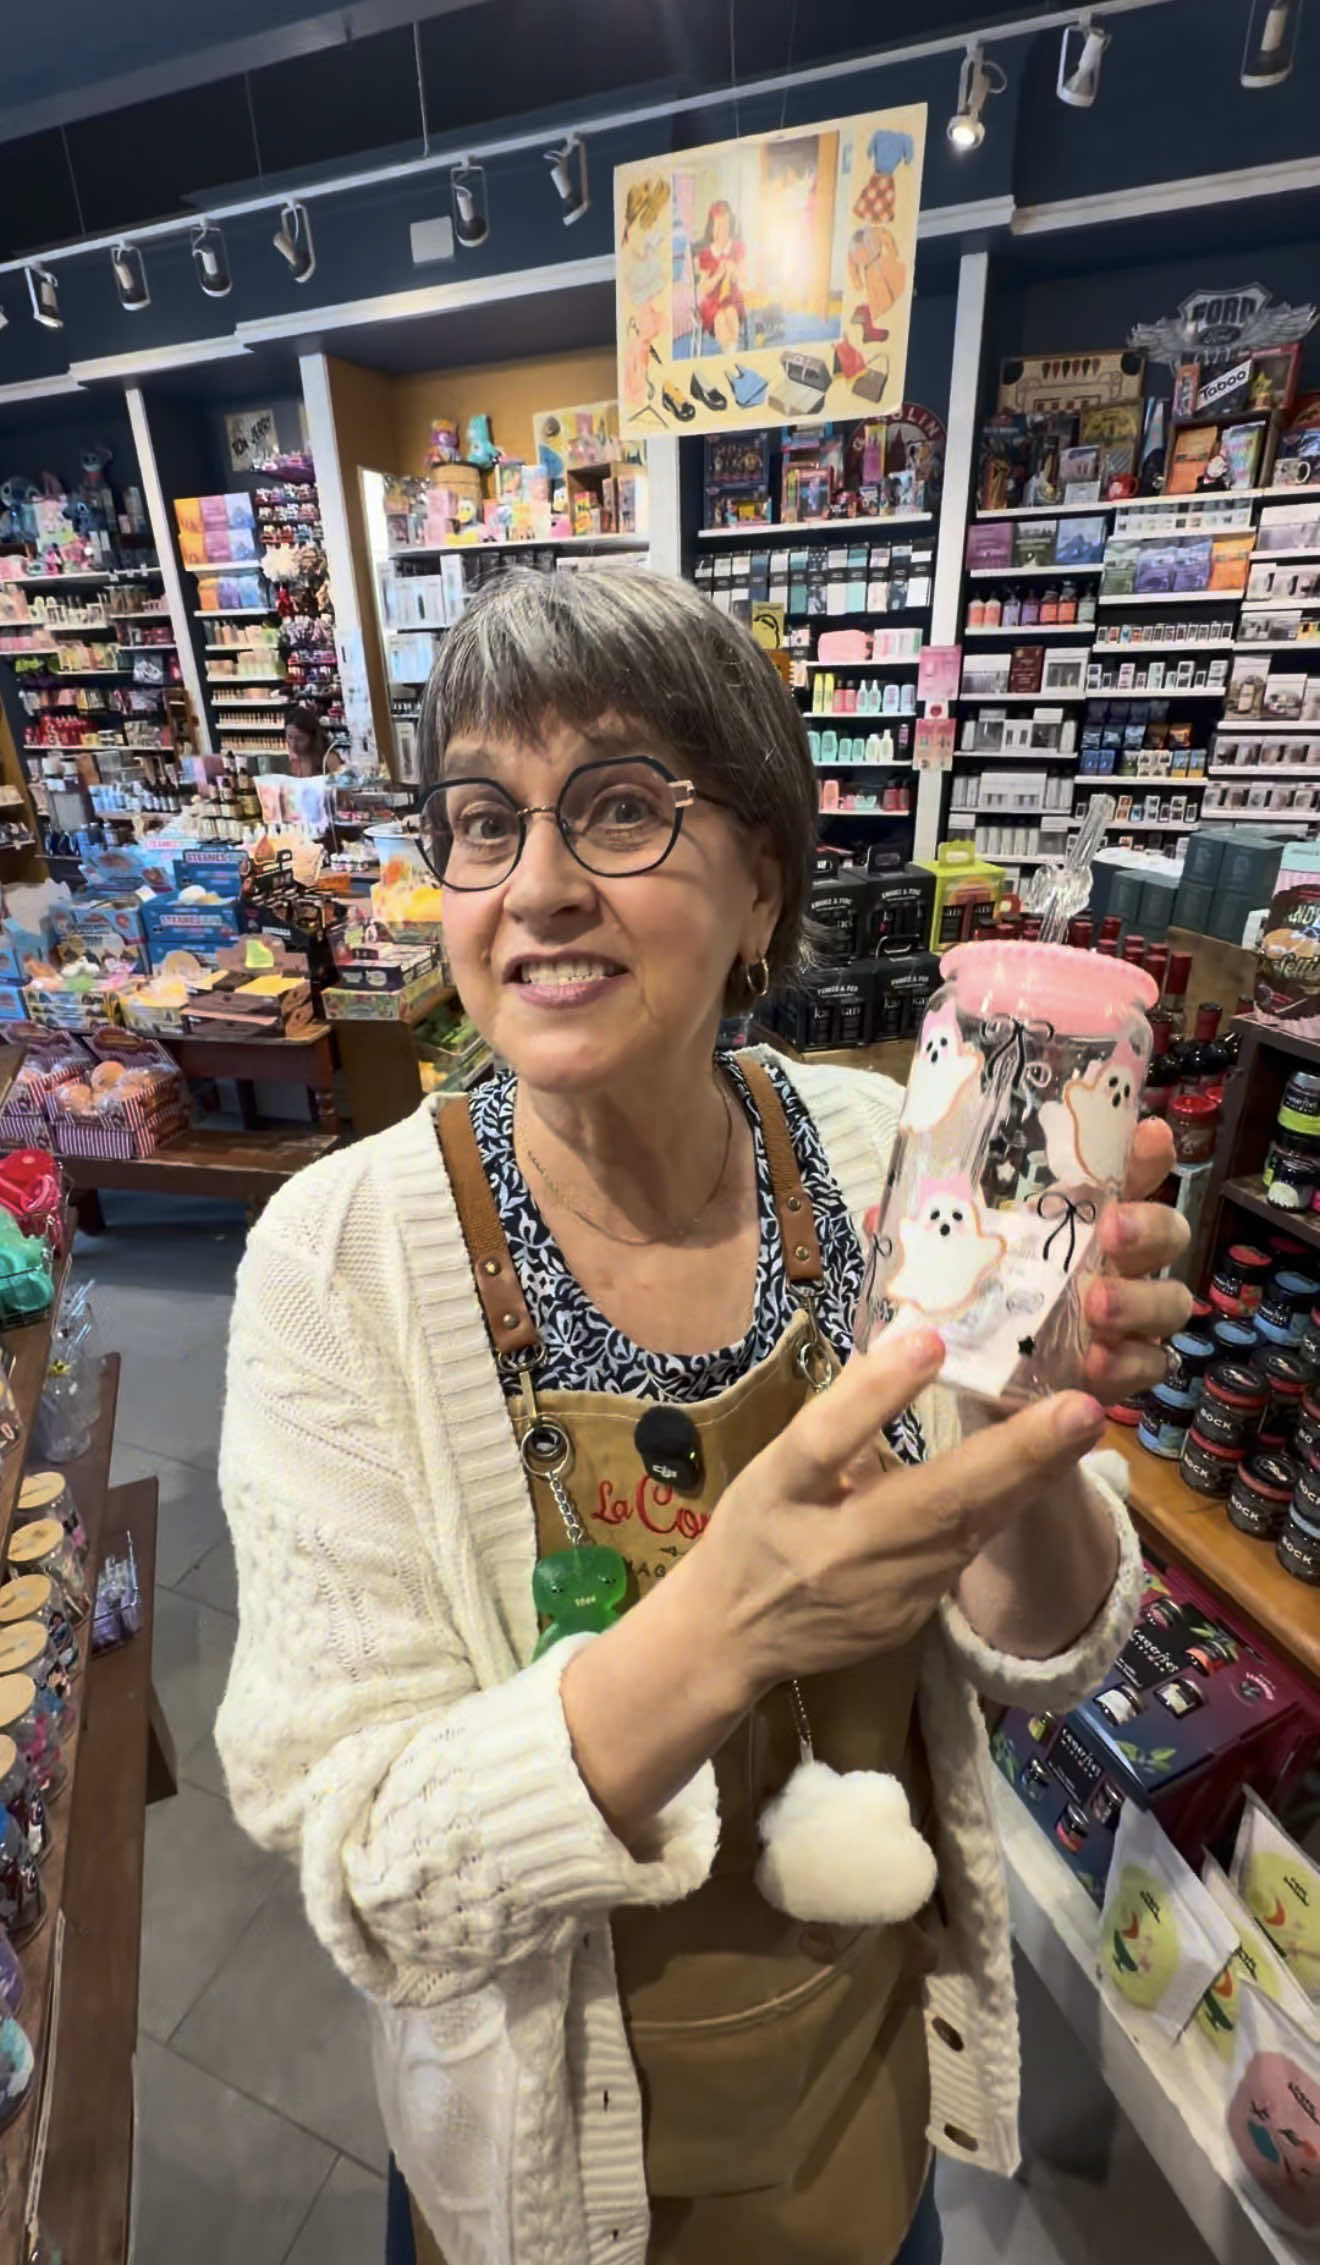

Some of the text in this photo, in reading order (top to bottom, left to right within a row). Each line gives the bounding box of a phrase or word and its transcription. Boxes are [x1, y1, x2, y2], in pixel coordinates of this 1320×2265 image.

[1192, 296, 1256, 323] FORD
[1199, 370, 1246, 400] Taboo
[590, 1480, 633, 1525] La
